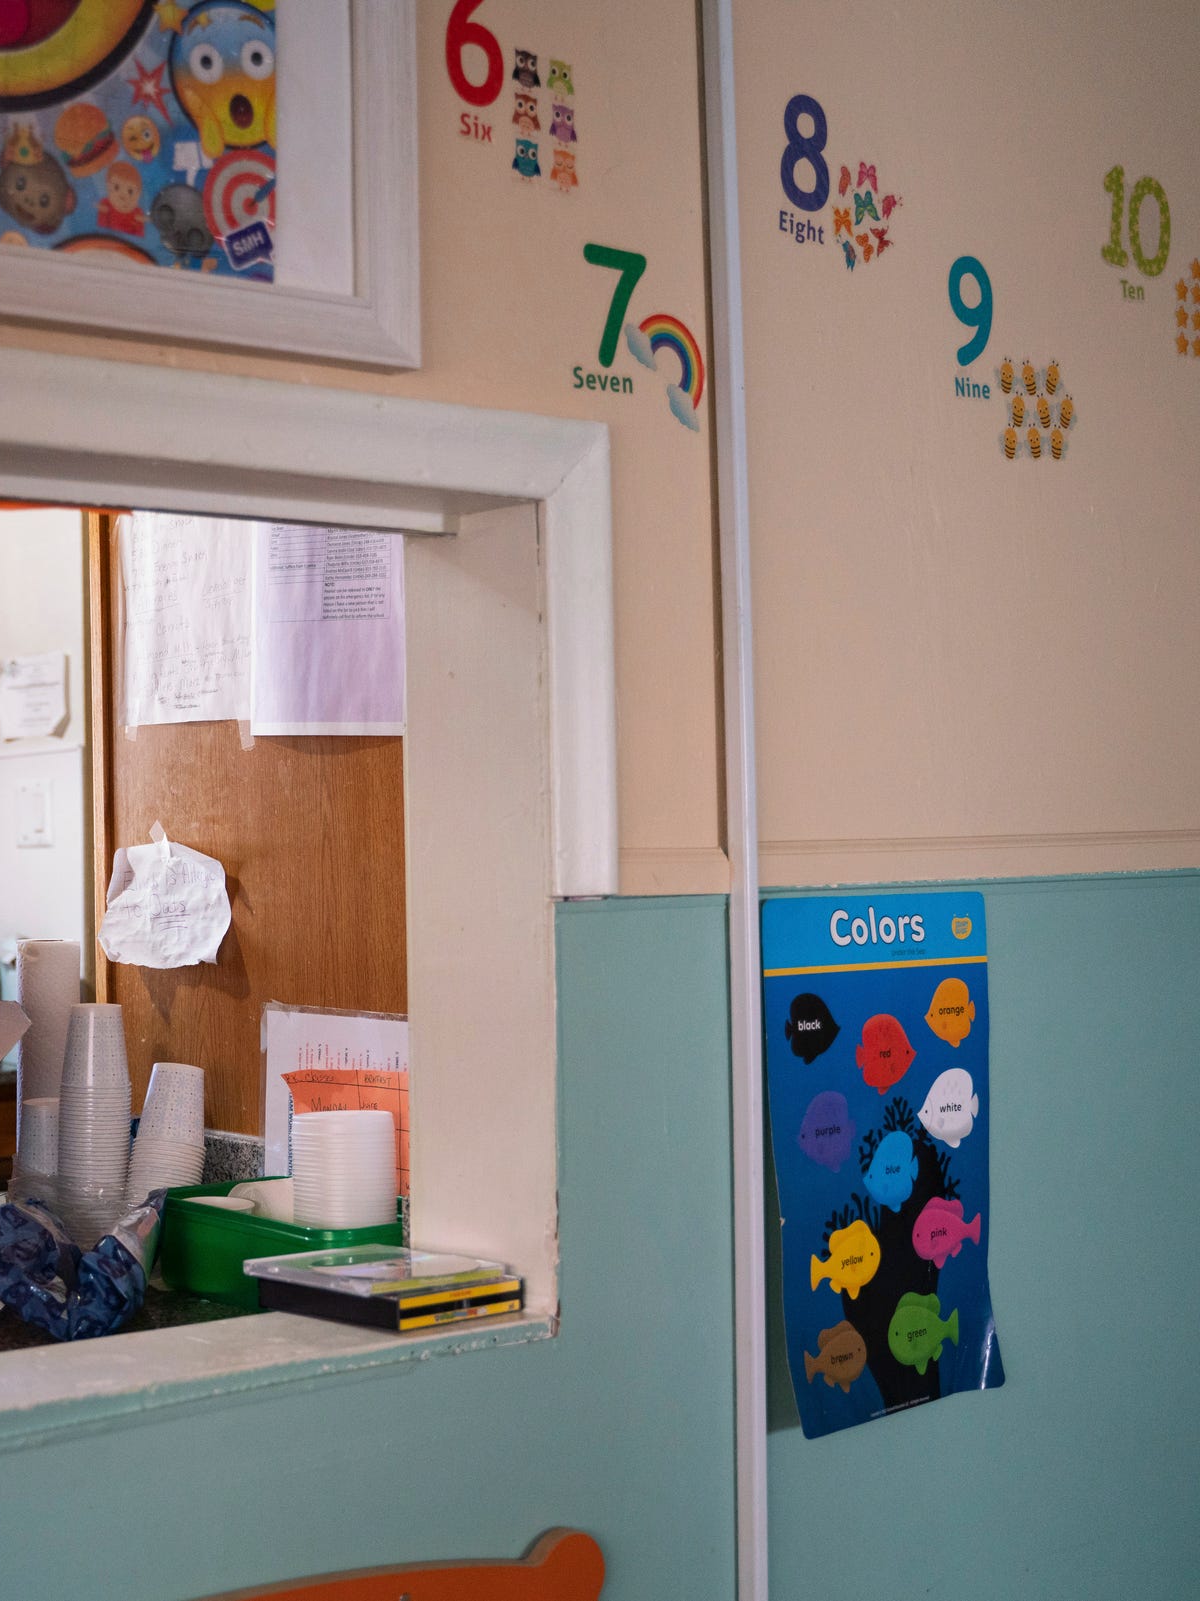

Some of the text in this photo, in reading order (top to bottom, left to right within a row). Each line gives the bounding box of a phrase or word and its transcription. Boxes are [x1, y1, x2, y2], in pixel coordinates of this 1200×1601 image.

[445, 0, 504, 107] 6
[460, 112, 494, 144] Six
[780, 94, 830, 212] 8
[778, 210, 825, 246] Eight
[1100, 164, 1171, 277] 10
[232, 230, 265, 256] SMH
[1119, 280, 1146, 301] Ten
[583, 243, 648, 368] 7
[948, 256, 993, 367] 9
[572, 366, 634, 394] Seven
[954, 377, 991, 400] Nine
[150, 892, 187, 917] Oats
[829, 905, 926, 948] Colors
[938, 1005, 965, 1016] orange
[797, 1019, 821, 1031] black
[879, 1048, 891, 1059] red
[939, 1102, 962, 1113] white
[814, 1125, 841, 1139] purple
[885, 1165, 901, 1175] blue
[930, 1227, 948, 1240] pink
[840, 1254, 864, 1269] yellow
[906, 1327, 927, 1341] green
[830, 1352, 854, 1364] brown
